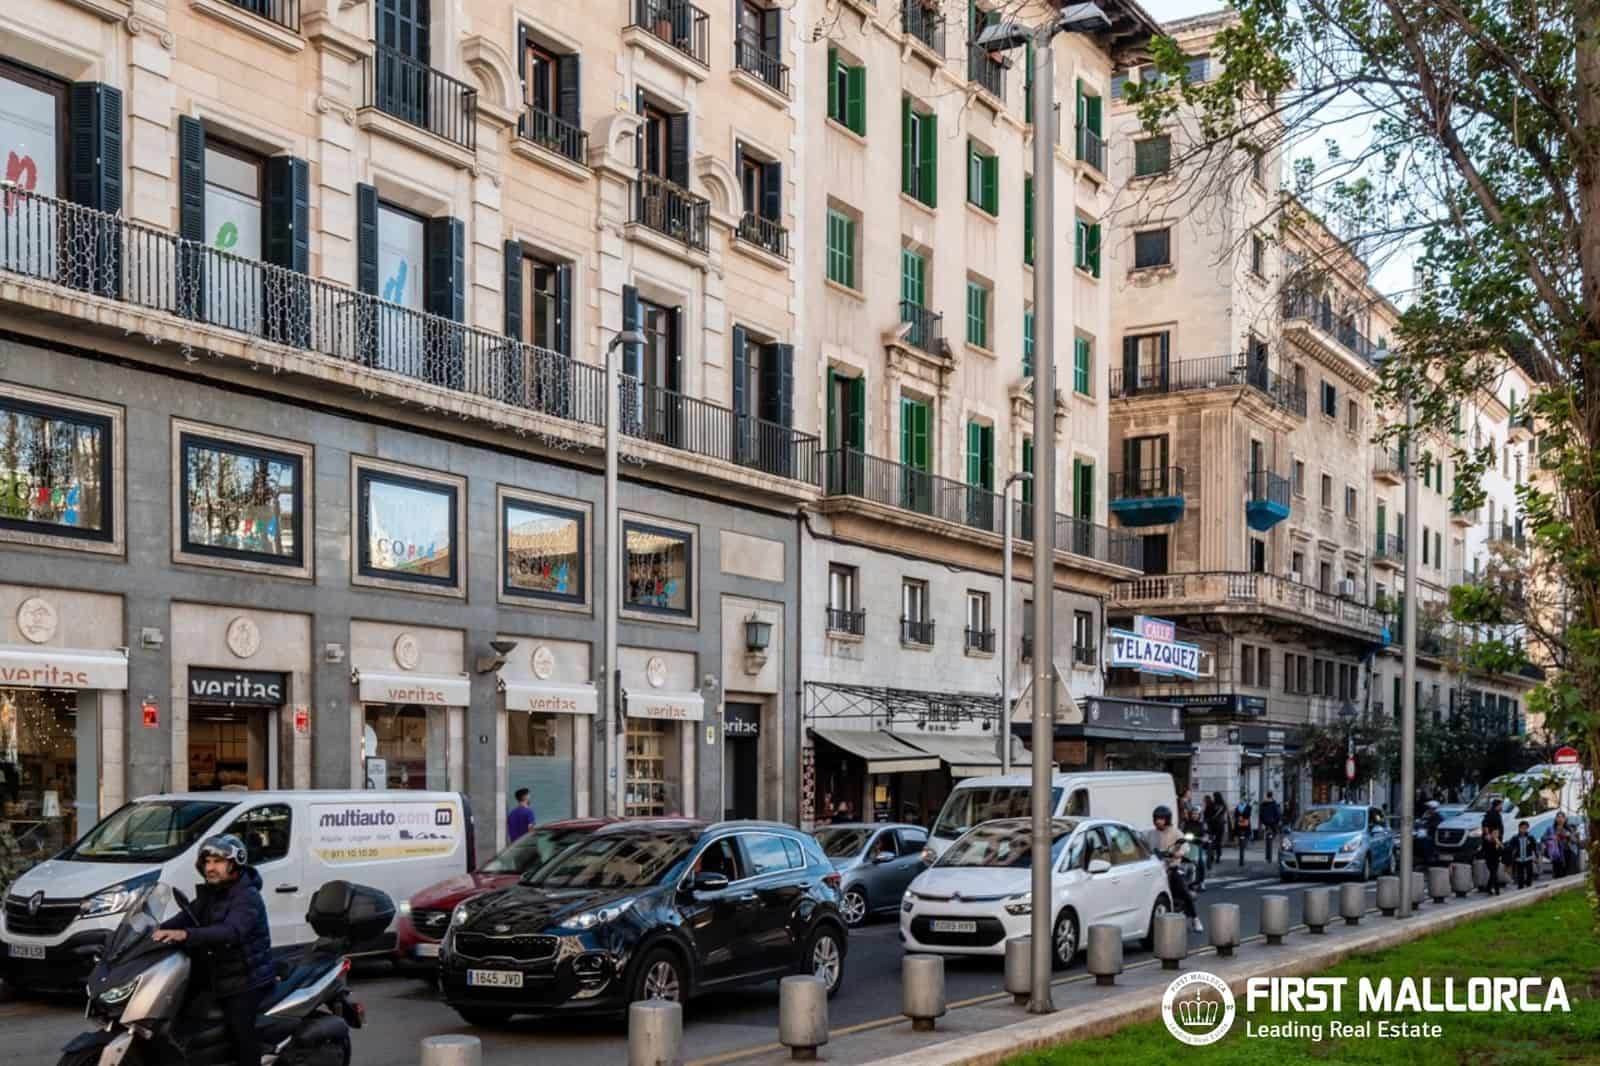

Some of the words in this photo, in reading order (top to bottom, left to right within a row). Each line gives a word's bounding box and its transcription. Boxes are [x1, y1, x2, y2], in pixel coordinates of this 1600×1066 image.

[1117, 637, 1196, 671] VELAZQUEZ
[1, 664, 89, 686] veritas
[191, 675, 281, 699] veritas
[388, 687, 445, 702] veritas
[529, 695, 577, 711] veritas
[645, 703, 688, 718] veritas
[475, 971, 498, 985] 1645
